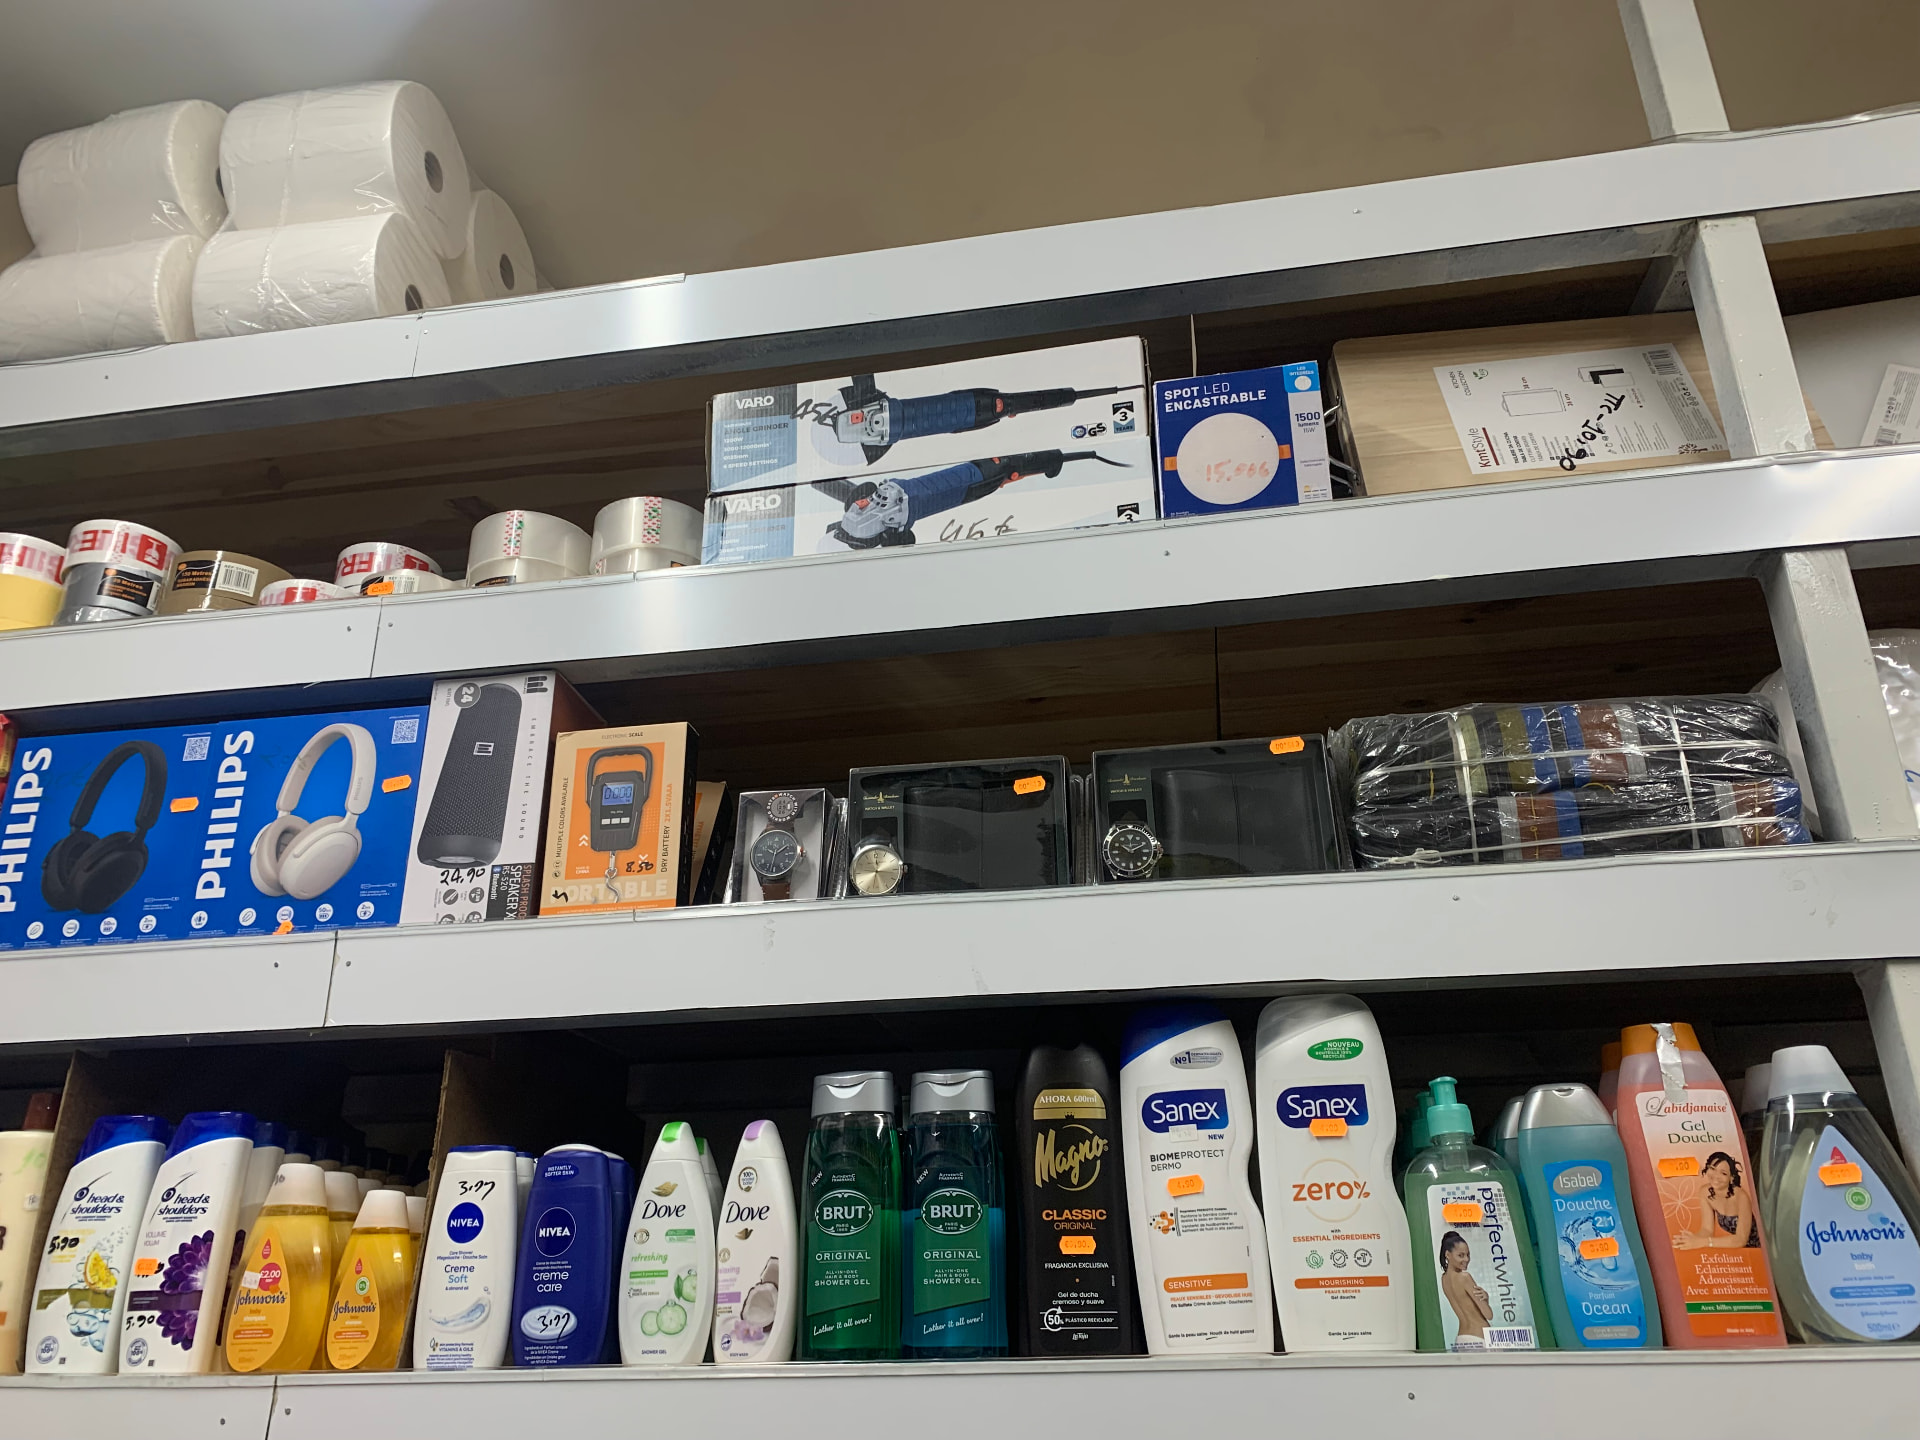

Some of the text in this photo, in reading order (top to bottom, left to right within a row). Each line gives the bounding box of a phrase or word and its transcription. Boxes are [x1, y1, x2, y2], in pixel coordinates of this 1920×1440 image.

[1448, 371, 1460, 390] KITCHEN
[1457, 370, 1472, 397] COLLECTION
[1164, 382, 1230, 401] SPOT LED
[735, 395, 775, 410] VARO
[1165, 389, 1267, 413] ENCASTRABLE
[1118, 411, 1128, 421] 3
[1294, 411, 1321, 422] 1500
[724, 425, 751, 436] ANGLE
[752, 422, 789, 433] GRINDER
[1087, 423, 1107, 437] GS
[728, 458, 778, 469] SPEED SETTINGS
[724, 494, 782, 515] VARO
[460, 685, 476, 703] 24
[518, 717, 537, 840] EMBRACE THE SOUND
[195, 730, 255, 900] PHILIPS
[555, 777, 569, 858] MULTIPLE COLORS AVAILABLE
[0, 747, 53, 913] PHILIPS
[660, 825, 671, 873] DRY BATTERY
[500, 865, 511, 892] RS-520
[520, 864, 532, 894] SPLASH
[490, 872, 500, 901] Bluetooth
[506, 865, 523, 911] SPEAKER
[1039, 1094, 1098, 1104] AHORA 600ml
[1286, 1094, 1360, 1119] Sanex
[1644, 1096, 1728, 1117] Labidjanaise
[1151, 1099, 1220, 1124] Sanex
[1681, 1119, 1706, 1132] Gel
[1667, 1132, 1723, 1145] Douche
[1035, 1128, 1107, 1189] Magno
[1149, 1149, 1225, 1162] BIOMEPROTECT
[1150, 1161, 1182, 1172] DERMO
[811, 1170, 824, 1187] NEW
[916, 1168, 929, 1185] NEW
[1559, 1171, 1599, 1189] Isabel
[70, 1203, 123, 1215] shoulders
[157, 1204, 209, 1215] shoulders
[641, 1199, 686, 1219] Dove
[725, 1200, 769, 1224] Dove
[822, 1205, 866, 1220] BRUT
[929, 1204, 975, 1219] BRUT
[1553, 1197, 1613, 1213] Douche
[1042, 1209, 1107, 1221] CLASSIC
[449, 1218, 480, 1228] NIVEA
[1053, 1221, 1097, 1231] ORIGINAL
[539, 1227, 571, 1238] NIVEA
[1292, 1233, 1381, 1243] ESSENTIAL INGREDIENTS
[1806, 1220, 1906, 1256] Johnson's
[631, 1252, 669, 1264] refreshing
[815, 1251, 872, 1261] ORIGINAL
[923, 1250, 982, 1260] ORIGINAL
[1477, 1187, 1517, 1323] perfectwhite
[1700, 1253, 1744, 1264] Exfoliant
[1850, 1252, 1873, 1261] baby
[444, 1264, 475, 1274] Creme
[533, 1271, 569, 1281] creme
[1695, 1264, 1753, 1275] Eclaircissant
[448, 1274, 469, 1283] Soft
[923, 1277, 961, 1285] SHOWER
[1168, 1279, 1213, 1290] SENSITIVE
[1319, 1278, 1365, 1287] NOURISHING
[1698, 1273, 1755, 1285] Adoucissant
[536, 1283, 563, 1292] care
[1686, 1284, 1769, 1296] Avec antibactérien
[234, 1290, 288, 1315] Johnson's
[1588, 1291, 1615, 1300] Parfum
[332, 1301, 377, 1321] Johnson's
[1582, 1301, 1632, 1316] Ocean
[813, 1324, 834, 1336] Lather
[843, 1318, 853, 1327] all
[854, 1313, 872, 1325] over!
[923, 1312, 984, 1335] Lather it all over!
[1048, 1314, 1064, 1325] 50%
